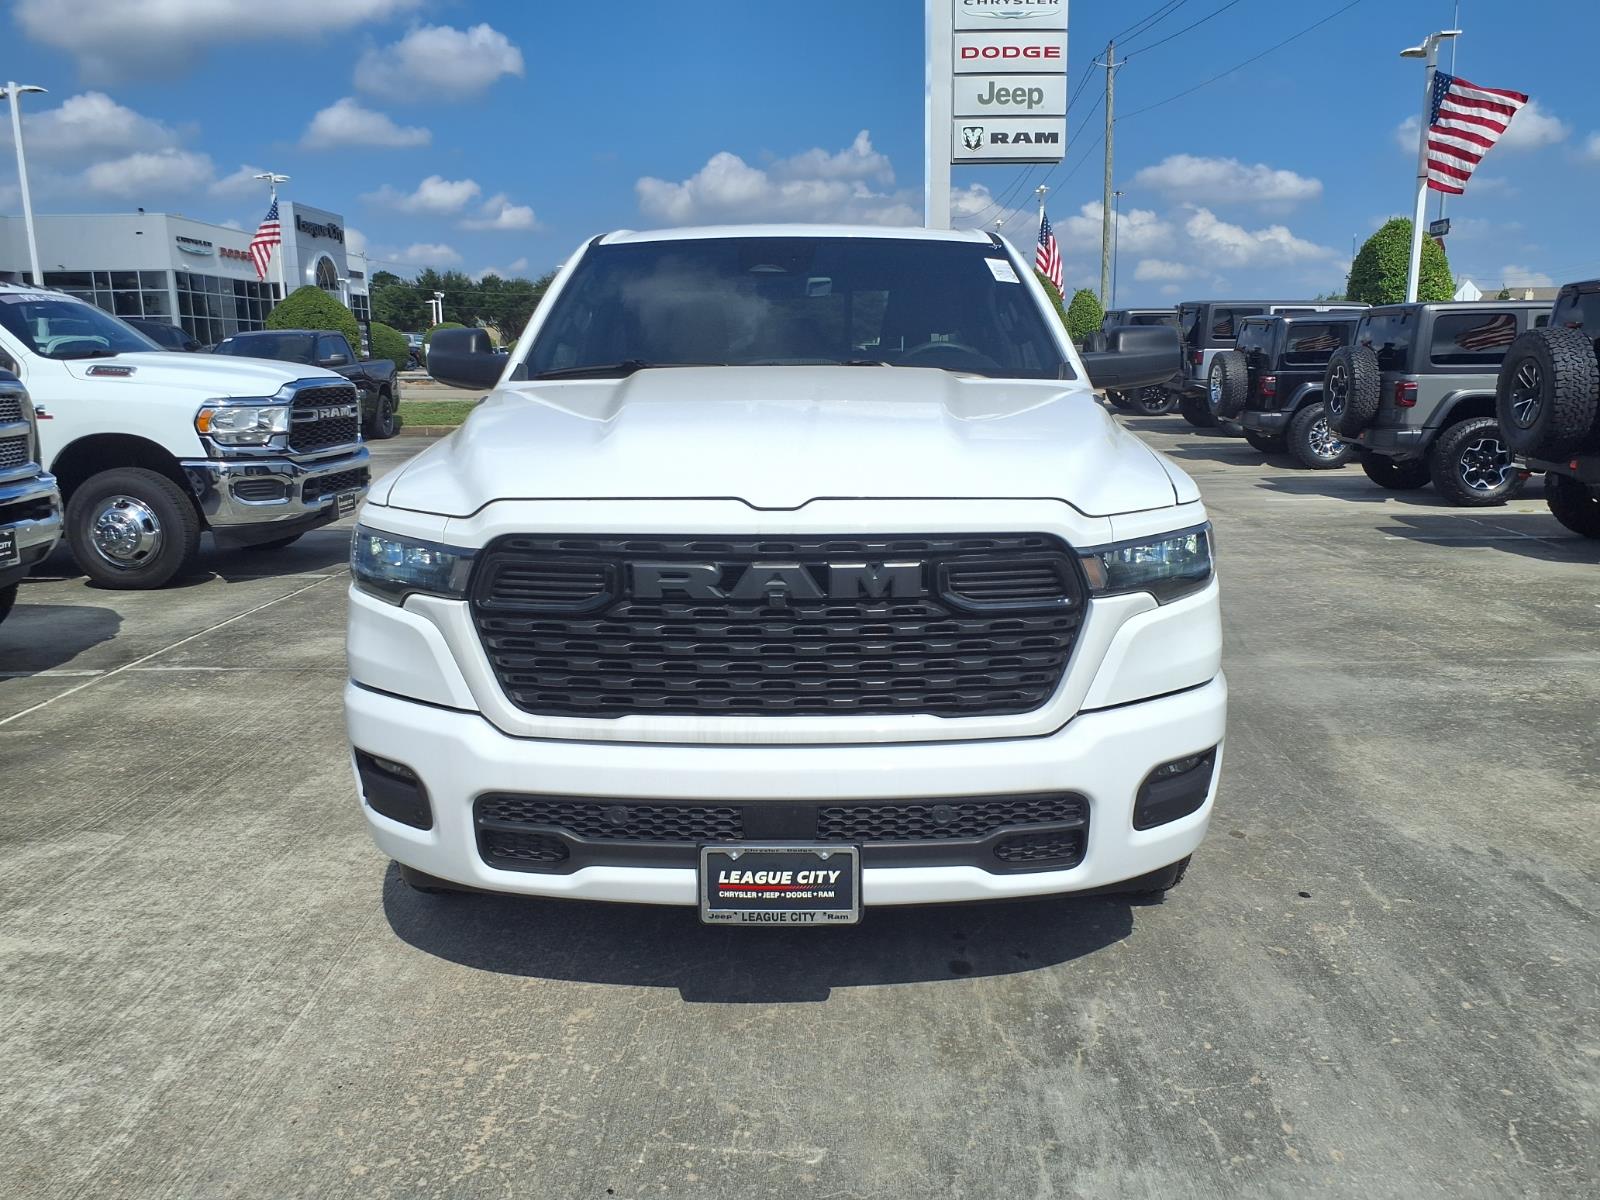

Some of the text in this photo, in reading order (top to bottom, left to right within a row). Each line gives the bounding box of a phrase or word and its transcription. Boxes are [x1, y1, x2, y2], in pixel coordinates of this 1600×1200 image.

[961, 46, 1061, 59] DODGE
[977, 81, 1044, 109] Jeep
[990, 132, 1059, 144] RAM
[296, 214, 344, 244] League City
[319, 406, 352, 418] RAM
[631, 561, 922, 599] RAM
[718, 870, 841, 884] LEAGUE CITY
[719, 890, 835, 899] CHRYSLER JEEP DODGE RAM
[741, 912, 787, 922] LEAGUE
[790, 912, 816, 922] CITY
